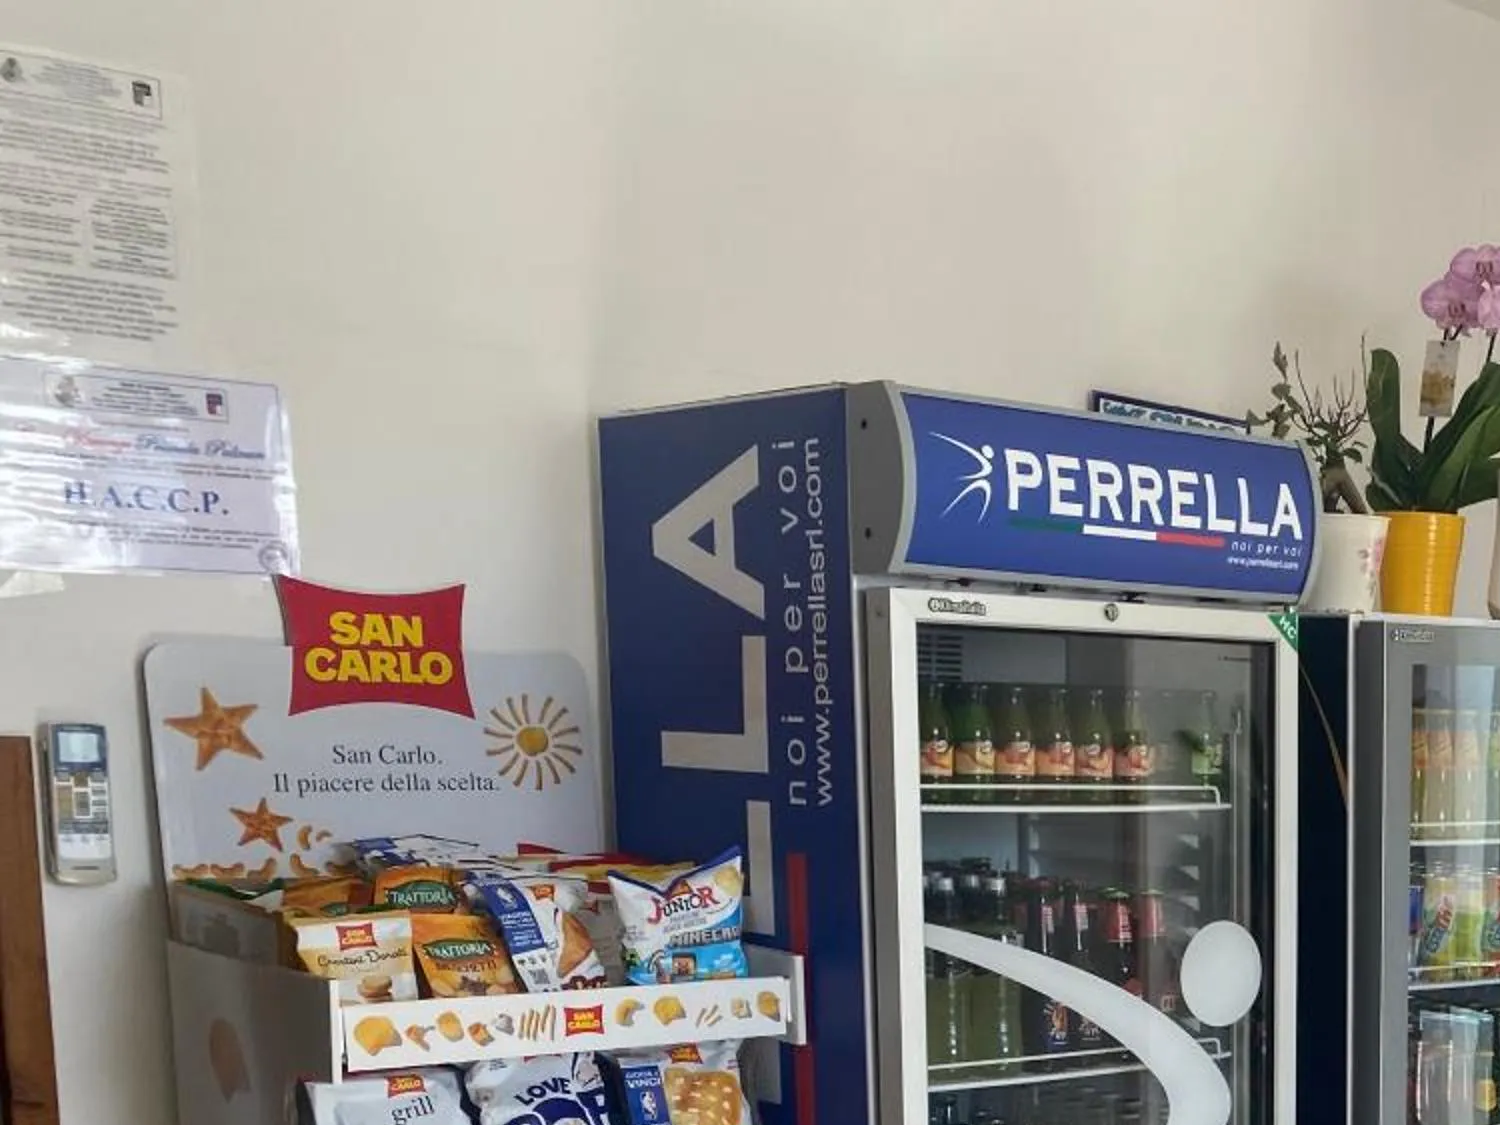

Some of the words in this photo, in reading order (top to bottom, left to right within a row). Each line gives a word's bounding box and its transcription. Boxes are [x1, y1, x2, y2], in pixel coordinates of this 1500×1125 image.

[772, 441, 801, 536] voi
[1004, 449, 1303, 540] PERRELLA
[1257, 544, 1279, 556] per
[329, 611, 423, 648] SAN
[784, 574, 809, 673] per
[804, 437, 833, 807] www.perrellasrl.com
[304, 648, 453, 685] CARLO
[332, 744, 372, 764] San
[379, 745, 443, 765] Carlo.
[781, 715, 807, 806] noi
[273, 773, 289, 793] Il
[297, 772, 374, 798] piacere
[381, 772, 431, 792] della
[437, 771, 500, 792] scelta.
[391, 889, 455, 905] TRATTORIA
[426, 942, 491, 957] TRATTORIA
[573, 1011, 595, 1020] SAN
[513, 1077, 573, 1106] LOVE
[391, 1096, 435, 1125] grill
